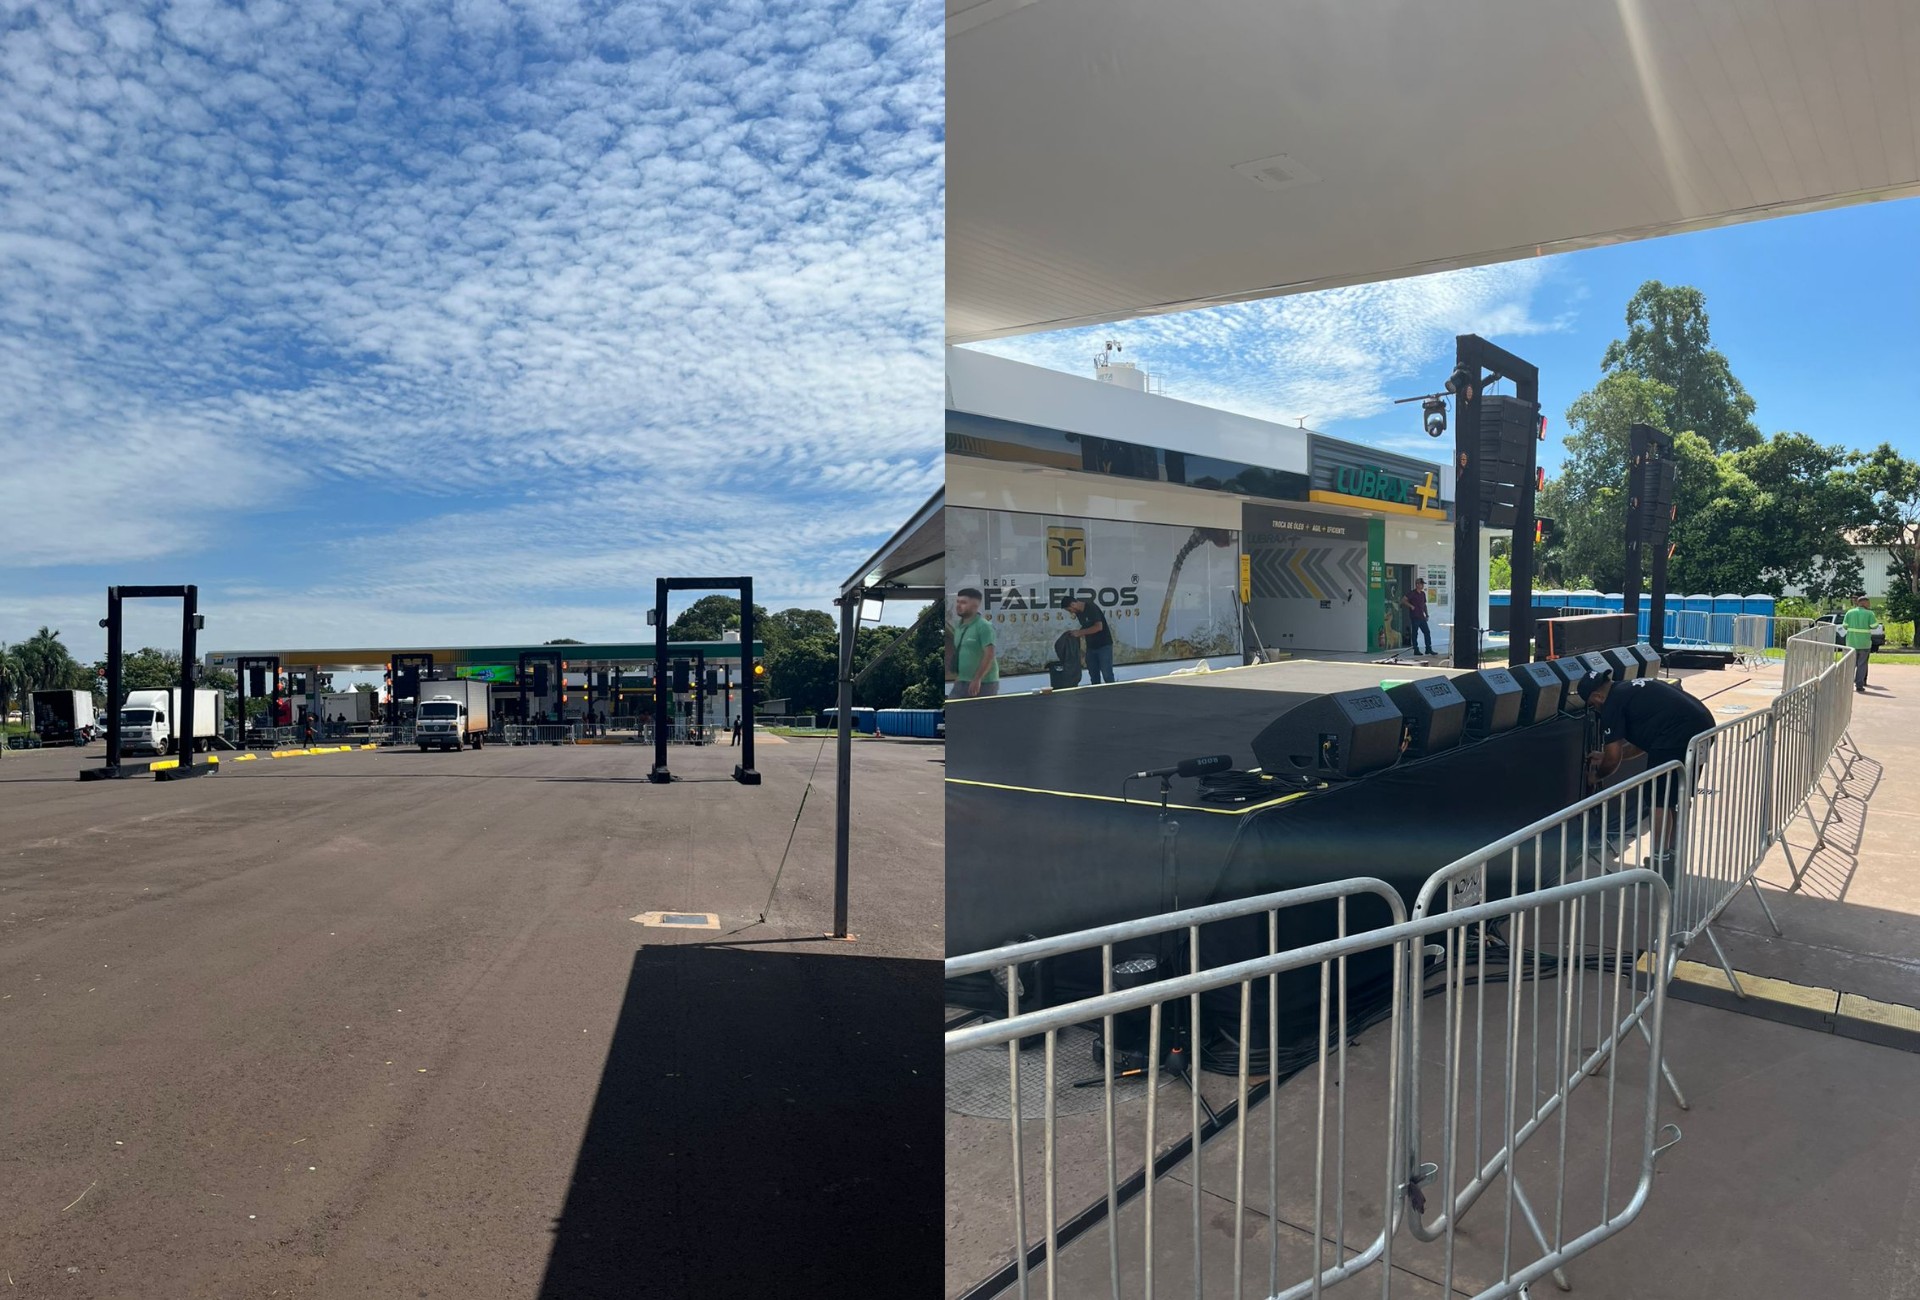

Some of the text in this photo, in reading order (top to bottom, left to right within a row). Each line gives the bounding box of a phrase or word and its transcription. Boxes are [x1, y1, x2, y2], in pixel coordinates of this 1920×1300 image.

[1336, 464, 1411, 503] LUBRAX
[984, 579, 1016, 587] REDE
[984, 611, 1050, 624] POSTOS
[1070, 608, 1140, 620] SIÇOS
